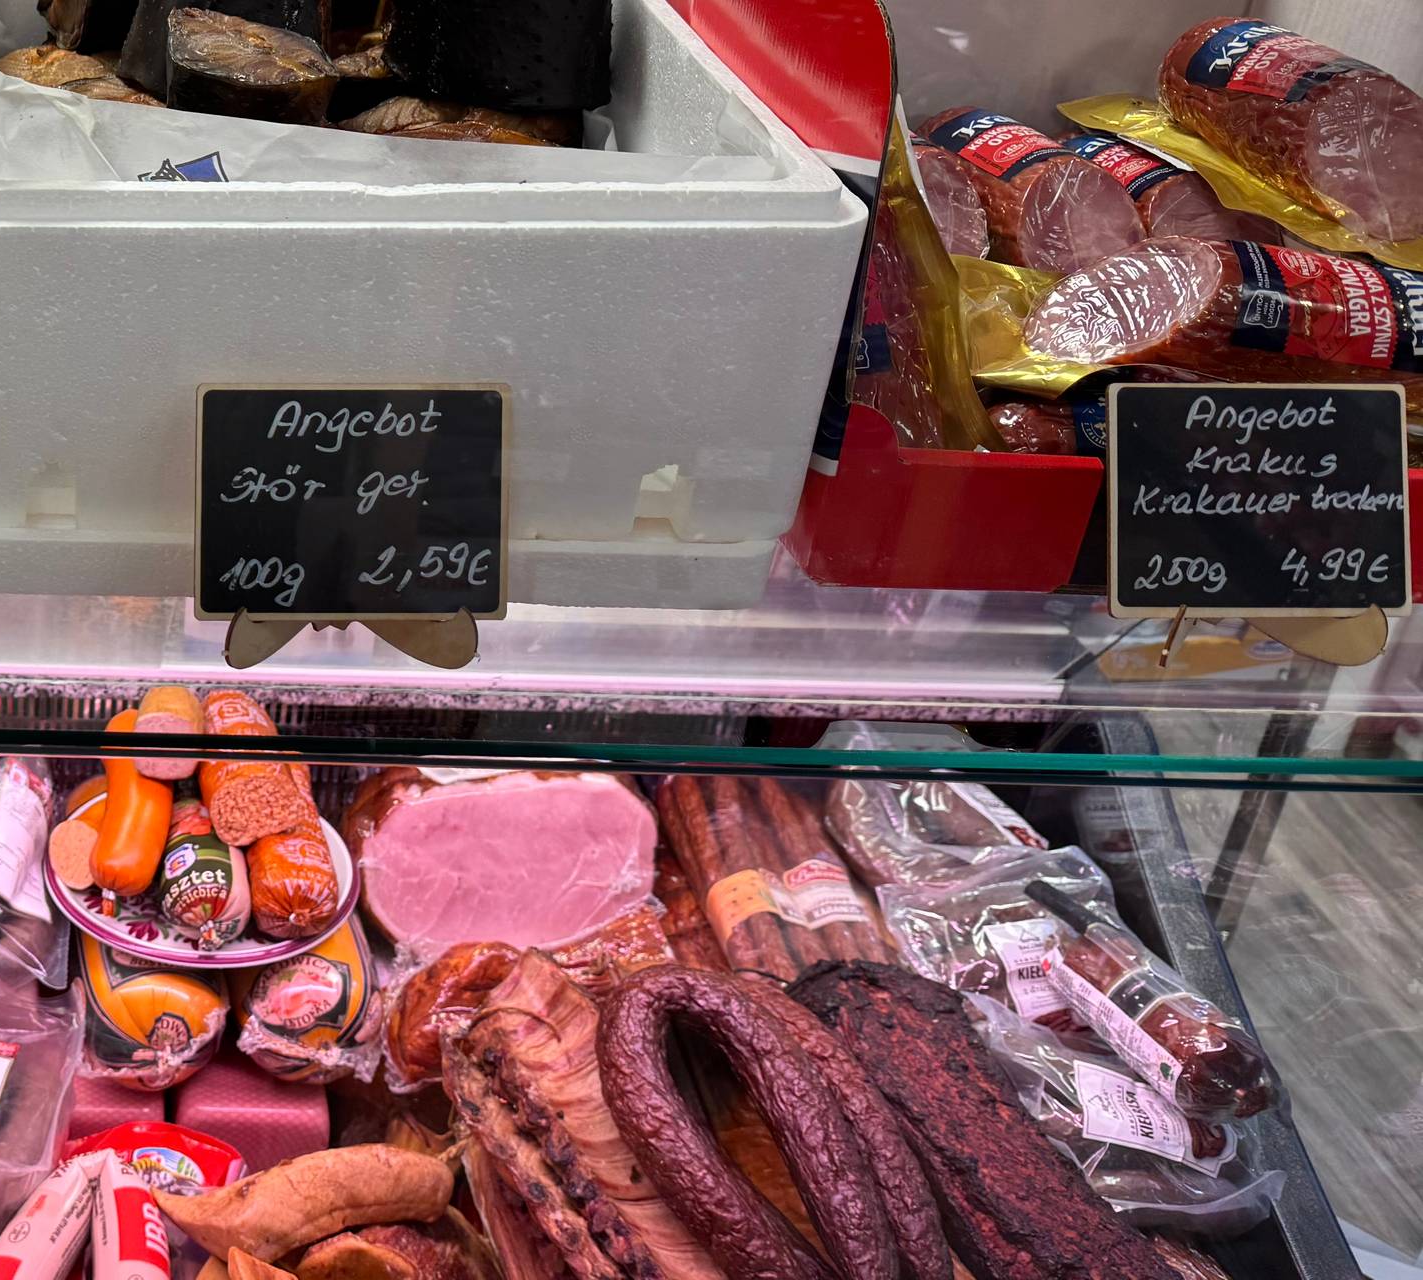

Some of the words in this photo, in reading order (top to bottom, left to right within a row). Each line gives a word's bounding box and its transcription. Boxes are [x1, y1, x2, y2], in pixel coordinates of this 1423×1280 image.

[1254, 51, 1279, 71] OD
[987, 133, 1013, 147] OD
[1329, 259, 1372, 337] SZWAGRA
[1371, 294, 1386, 305] Z
[1371, 306, 1393, 358] SZYNKI
[267, 399, 443, 453] Angebot
[1185, 395, 1338, 445] Angebot
[1185, 445, 1338, 478] Krakus
[220, 464, 327, 503] Stör
[356, 470, 430, 515] ger.
[1132, 483, 1301, 516] Krakauer
[219, 556, 306, 608] 100g
[358, 542, 493, 594] 2,59€
[1134, 553, 1228, 593] 250g
